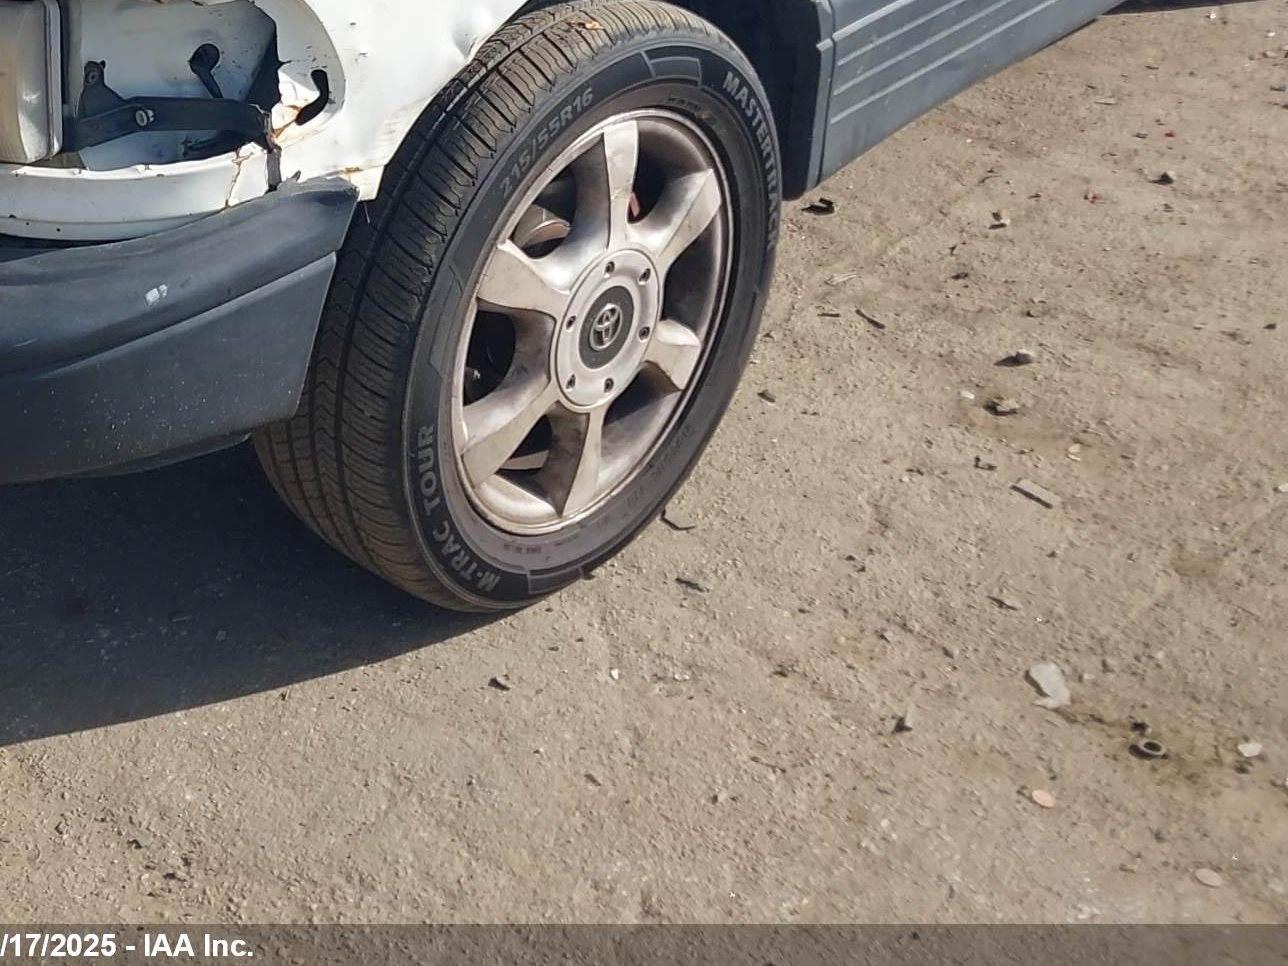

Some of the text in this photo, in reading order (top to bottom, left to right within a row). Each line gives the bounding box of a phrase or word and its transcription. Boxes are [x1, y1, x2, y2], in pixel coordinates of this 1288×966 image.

[499, 87, 594, 197] 215/55R16
[722, 70, 778, 252] MASTERTRACK
[417, 424, 501, 592] M-TRAC TOUR
